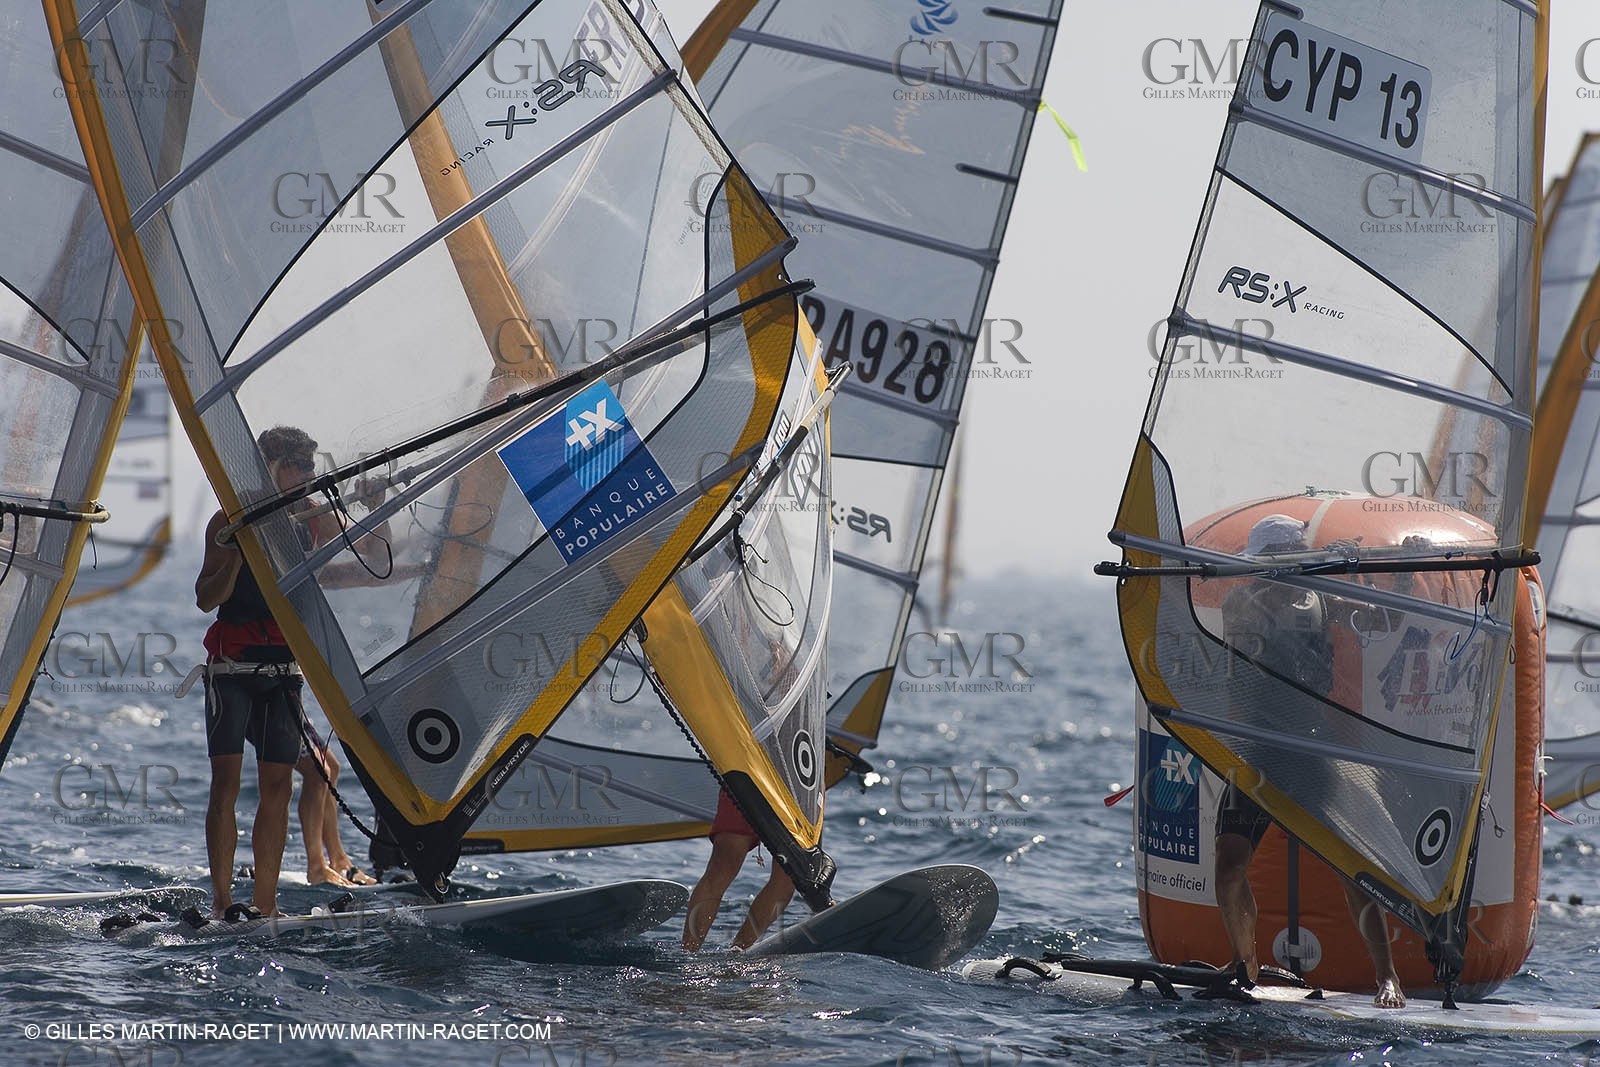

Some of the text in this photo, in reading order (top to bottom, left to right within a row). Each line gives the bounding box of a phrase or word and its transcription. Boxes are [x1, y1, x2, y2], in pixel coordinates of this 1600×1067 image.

[1262, 29, 1422, 149] CYP 13
[1217, 266, 1345, 320] RS:X RACING
[555, 467, 657, 540] BANQUE
[565, 483, 668, 557] POPULAIRE
[491, 740, 531, 789] NEILPRYDE
[1169, 873, 1207, 892] officiel
